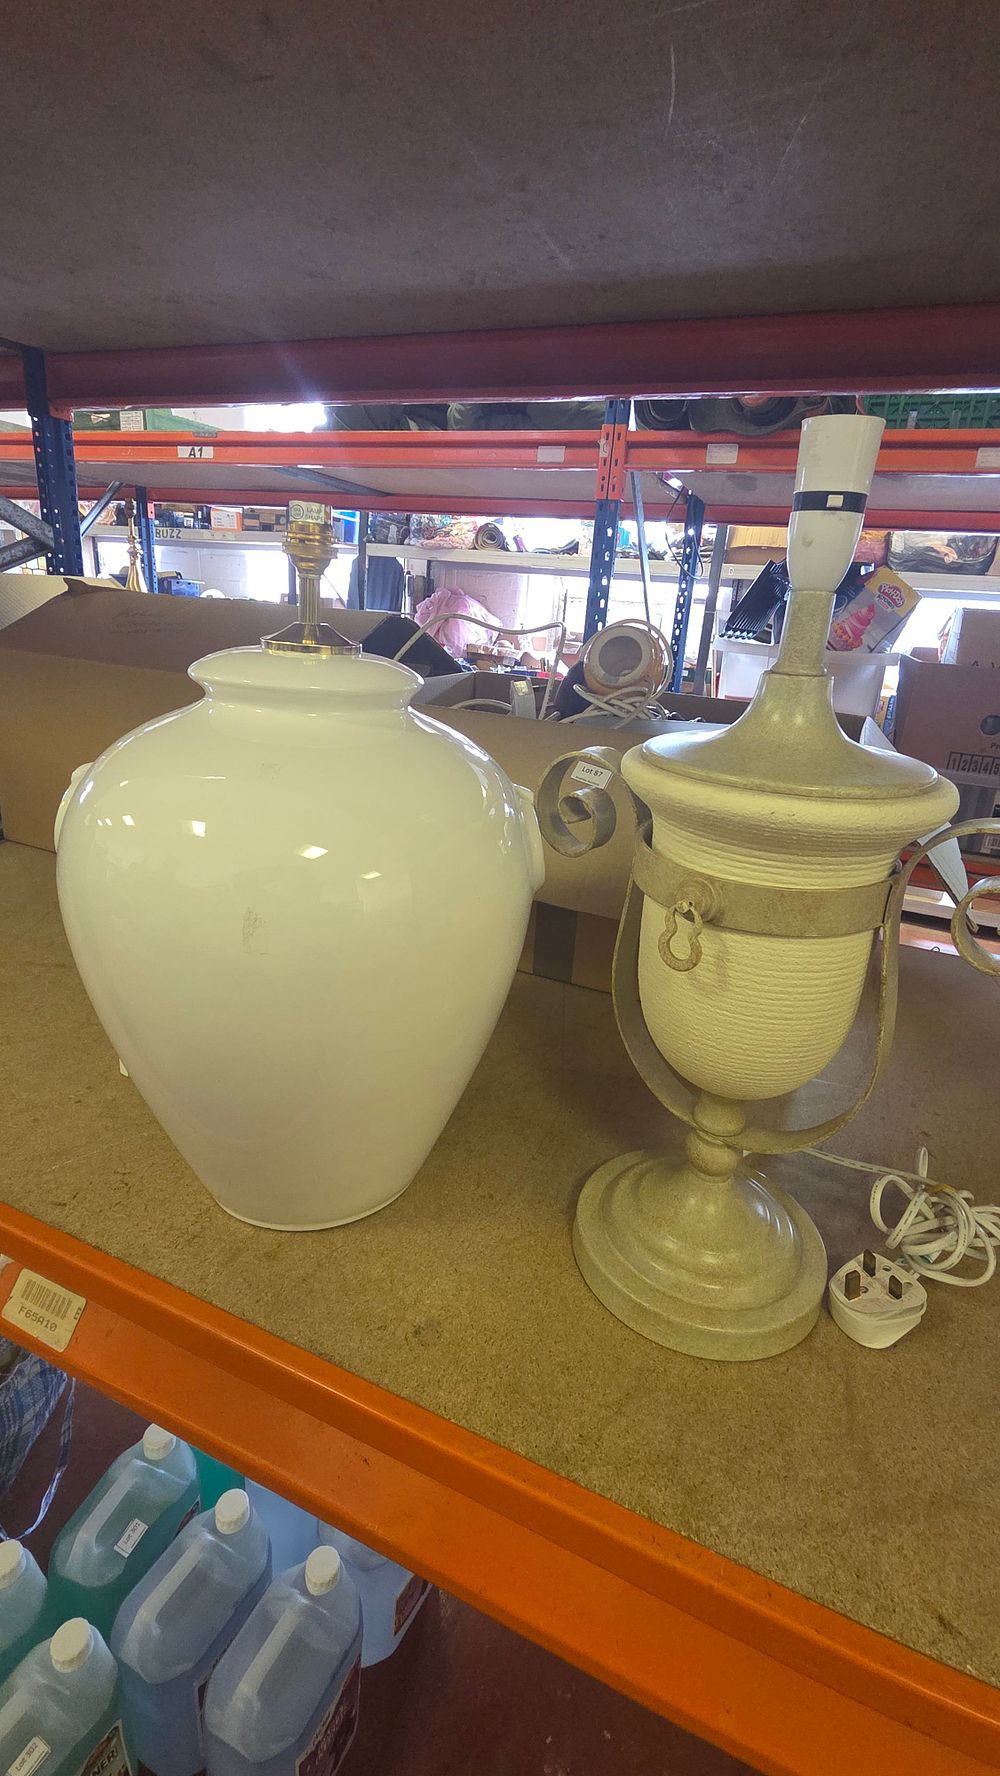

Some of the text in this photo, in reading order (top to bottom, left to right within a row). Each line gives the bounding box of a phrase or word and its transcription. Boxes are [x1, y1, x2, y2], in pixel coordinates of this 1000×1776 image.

[188, 446, 203, 458] A1
[155, 528, 182, 539] BUZZ
[581, 766, 593, 775] Lot
[18, 1305, 58, 1332] F65A10
